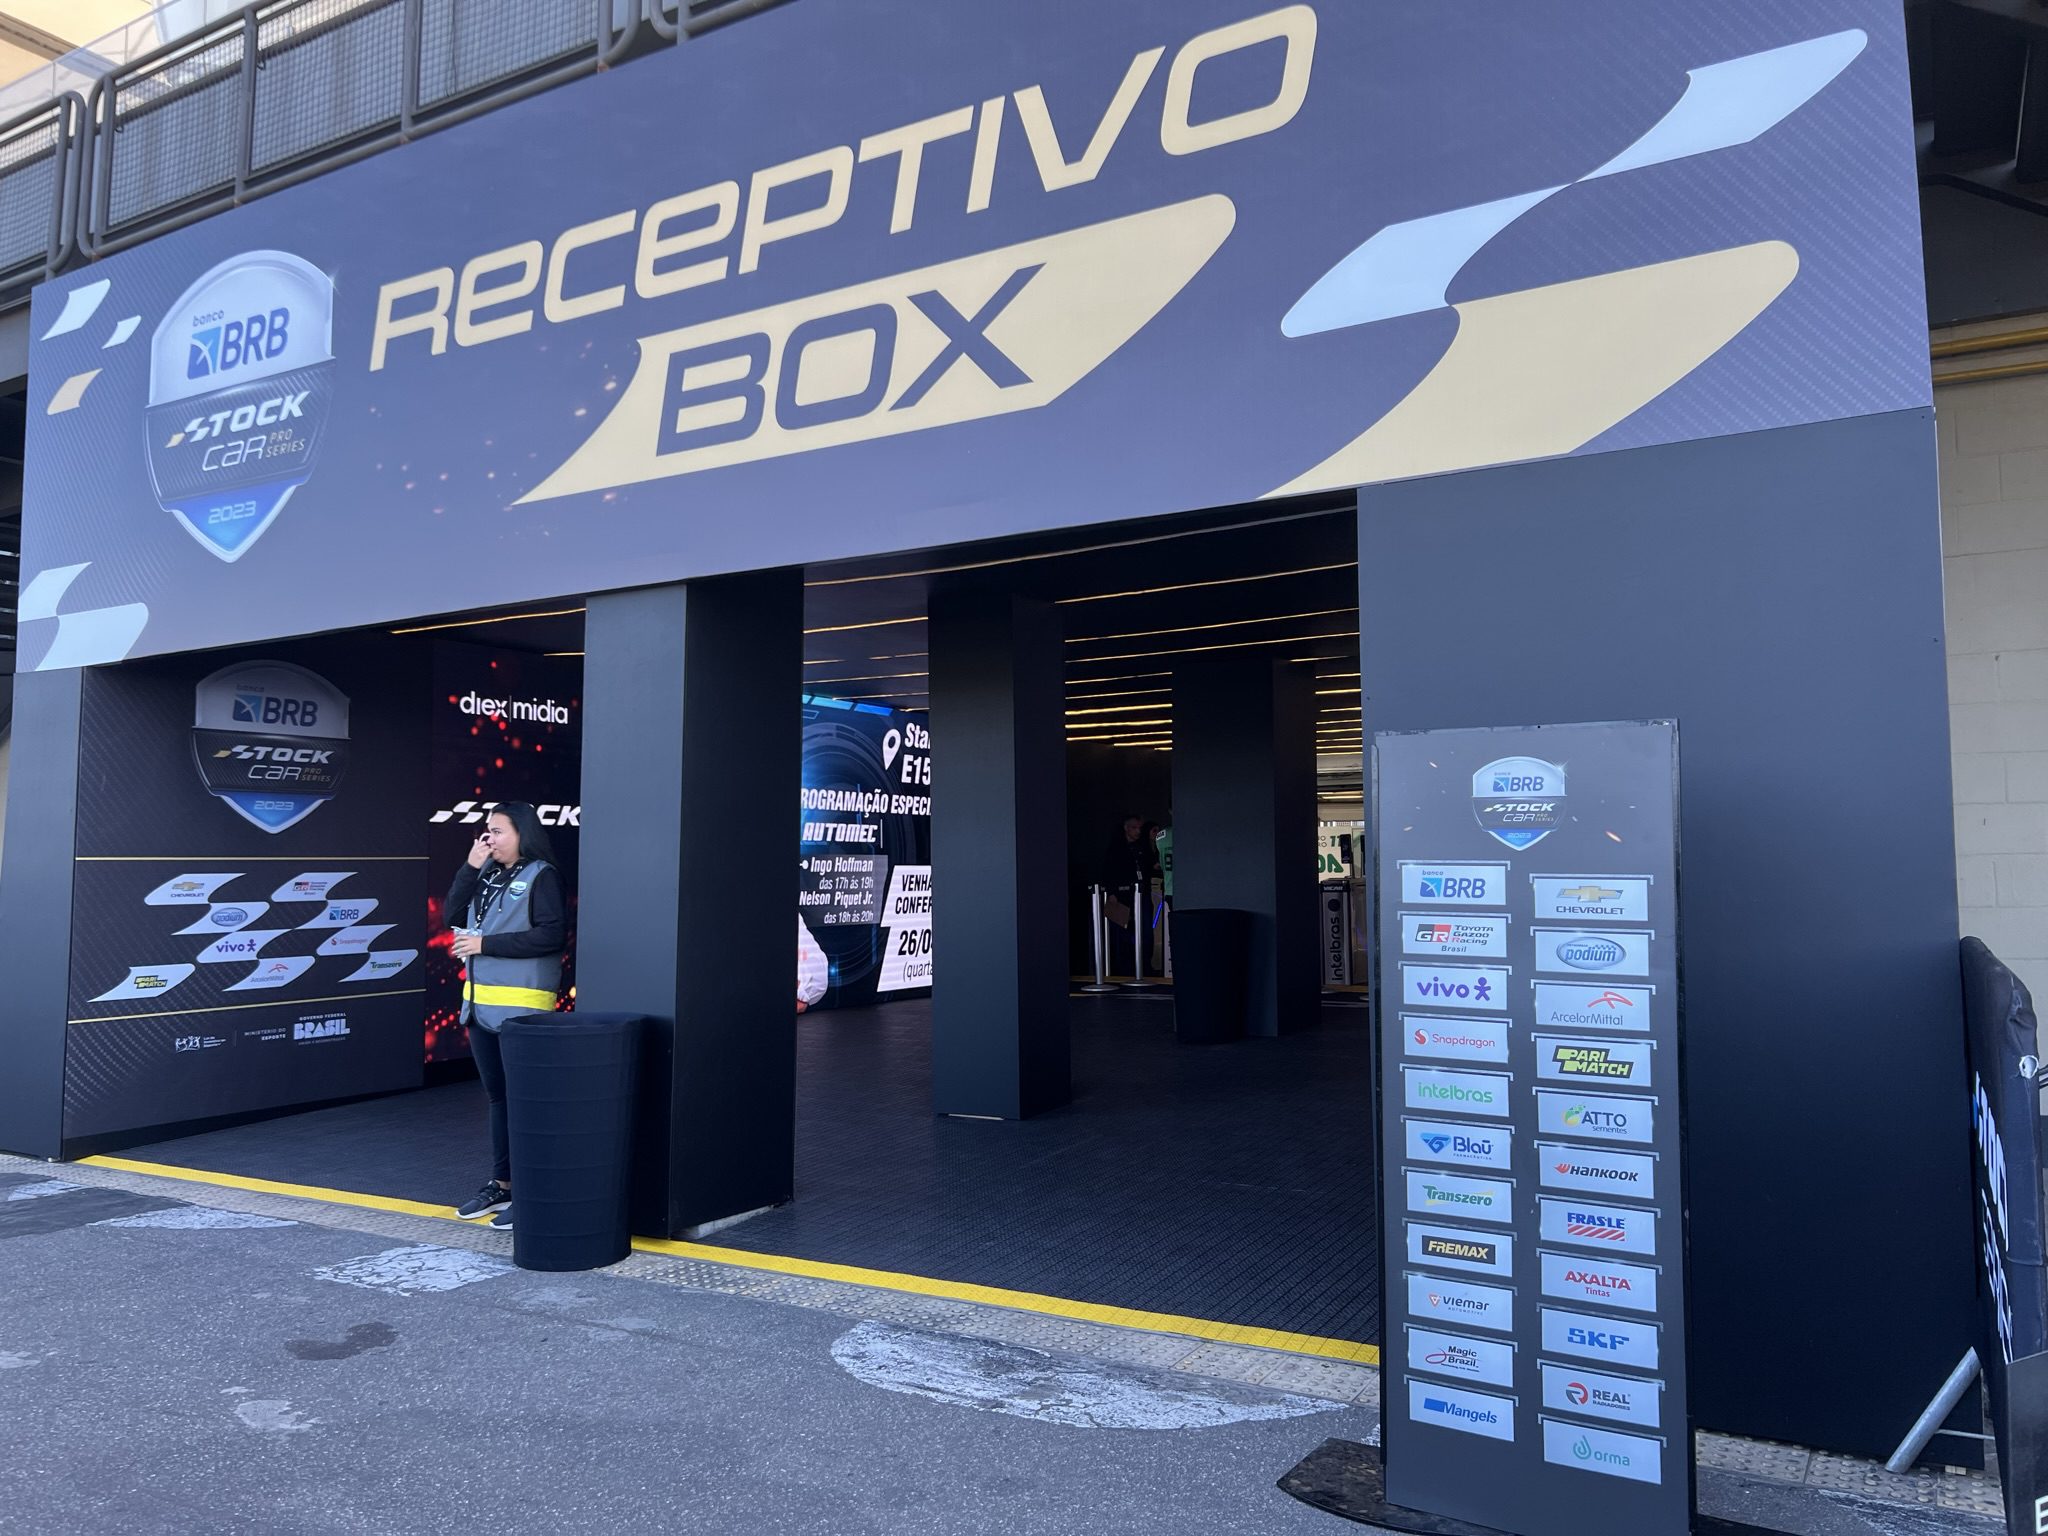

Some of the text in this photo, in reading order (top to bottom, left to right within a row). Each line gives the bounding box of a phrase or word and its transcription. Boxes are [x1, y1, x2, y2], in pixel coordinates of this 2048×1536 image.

[369, 4, 1318, 372] RECEPTIVO
[192, 309, 225, 327] banco
[220, 307, 290, 371] BRB
[655, 263, 1048, 458] BOX
[184, 390, 311, 443] STOCK
[270, 428, 293, 443] PRO
[265, 438, 306, 458] SERIES
[208, 500, 257, 525] 2023
[262, 696, 319, 727] BRB
[459, 691, 569, 725] diex midia
[232, 745, 335, 764] STOCK
[1510, 776, 1545, 792] BRB
[254, 800, 295, 811] 2023
[1493, 803, 1556, 812] STOCK
[802, 822, 878, 843] AUTOMEC
[811, 857, 874, 876] Ingo Hoffman
[819, 877, 833, 890] das
[835, 877, 849, 890] 17h
[861, 876, 874, 890] 19h
[1443, 877, 1486, 899] BRB
[799, 891, 874, 909] Nelson Piquet Jr.
[339, 909, 360, 921] BRB
[824, 912, 837, 924] das
[839, 911, 850, 924] 18h
[861, 911, 874, 923] 20h
[1556, 905, 1625, 915] CHEVROLET
[1416, 924, 1494, 943] GR TOYOTA
[1452, 937, 1488, 946] Racing
[216, 941, 245, 953] vivo
[1330, 916, 1343, 981] intelbras
[1441, 945, 1467, 953] Brasil
[1565, 946, 1617, 962] podium
[1417, 976, 1470, 998] vivo
[1551, 1011, 1623, 1026] ArcelorMittal
[294, 1019, 351, 1040] BRASIL
[1432, 1033, 1496, 1048] Snapdragon
[1557, 1048, 1606, 1063] PARI
[1563, 1060, 1630, 1076] MATCH
[1418, 1082, 1493, 1103] intelbras
[1582, 1111, 1627, 1128] ATTO
[1592, 1125, 1628, 1135] sementes
[1423, 1185, 1493, 1206] Transzero
[1428, 1240, 1489, 1260] FREMAX
[1564, 1270, 1631, 1291] AXALTA
[1585, 1286, 1611, 1298] Tintas
[1567, 1327, 1630, 1350] SKF
[1448, 1345, 1478, 1358] Magic
[1592, 1388, 1630, 1405] REAL
[1444, 1401, 1498, 1424] Mangels
